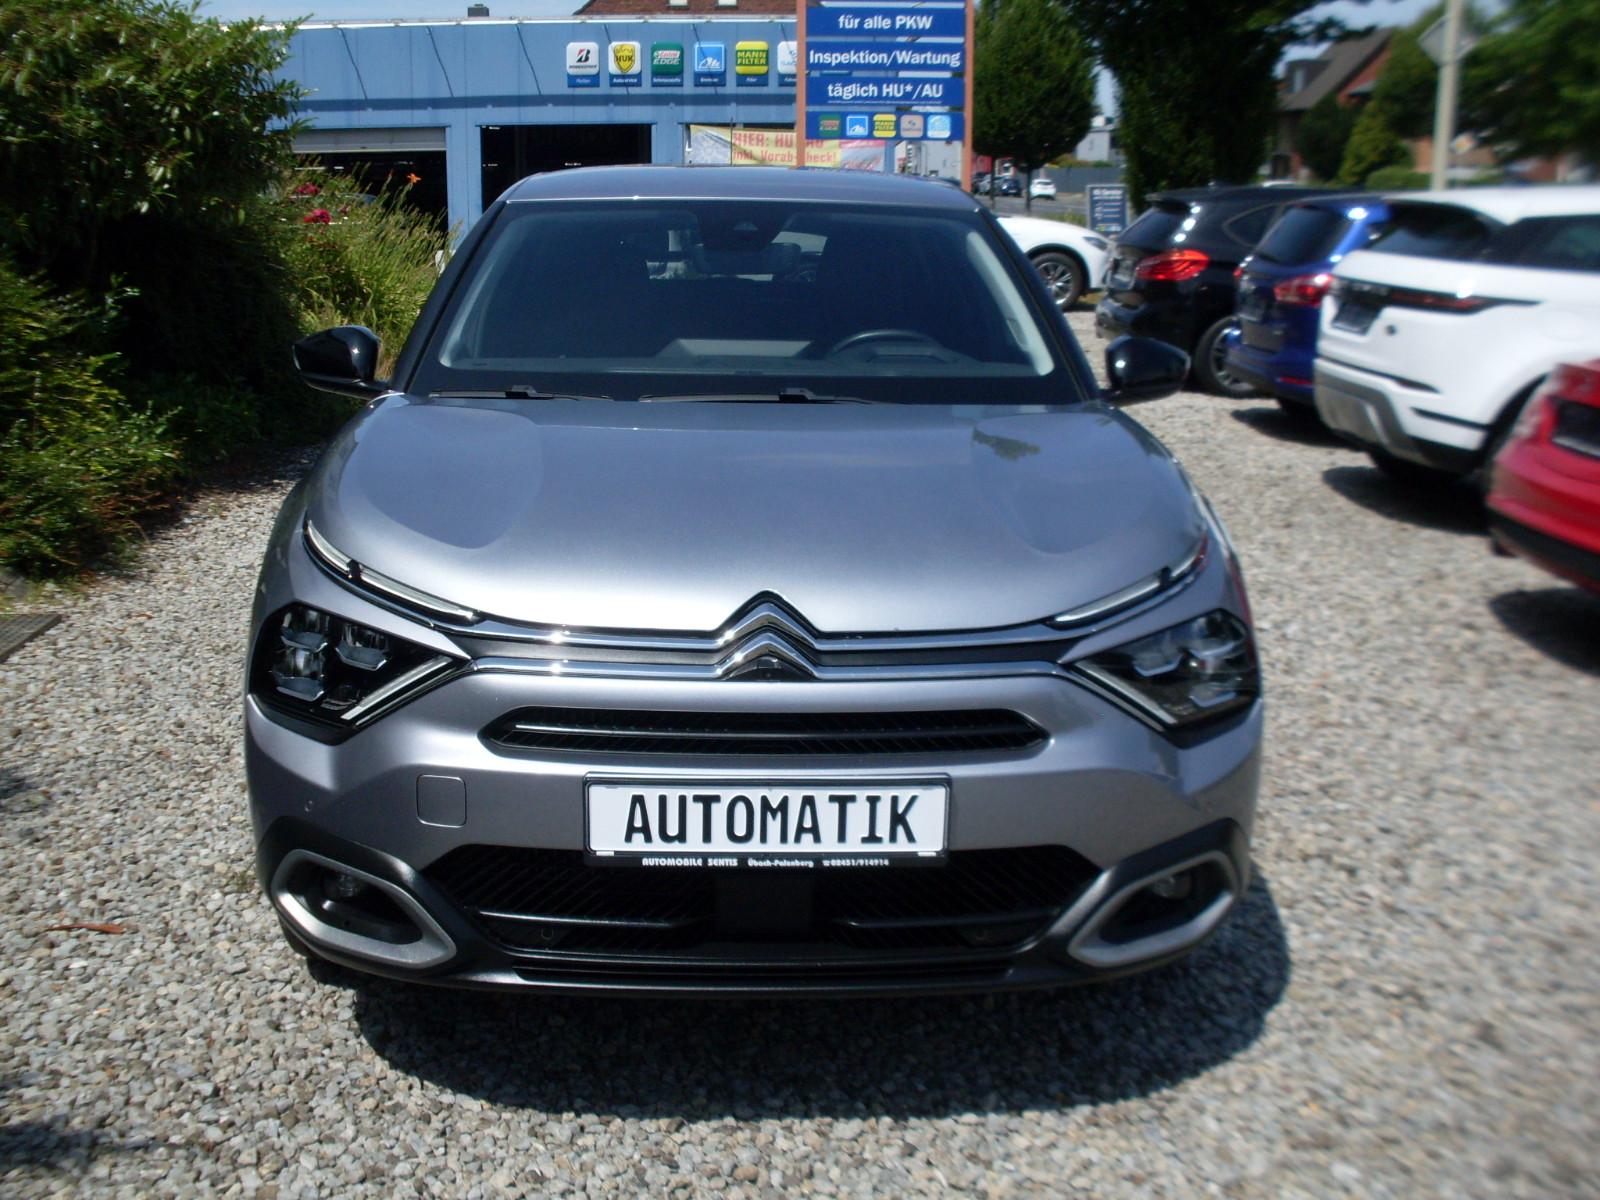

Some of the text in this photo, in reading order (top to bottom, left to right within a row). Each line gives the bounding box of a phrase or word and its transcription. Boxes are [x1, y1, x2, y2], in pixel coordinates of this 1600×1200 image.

[838, 14, 933, 29] für alle PKW
[809, 50, 961, 67] Inspektion/Wartung
[827, 83, 878, 100] täglich
[623, 794, 919, 844] AUTOMATIK
[642, 857, 702, 866] AUTOMOBILE
[707, 858, 738, 866] SENTIS
